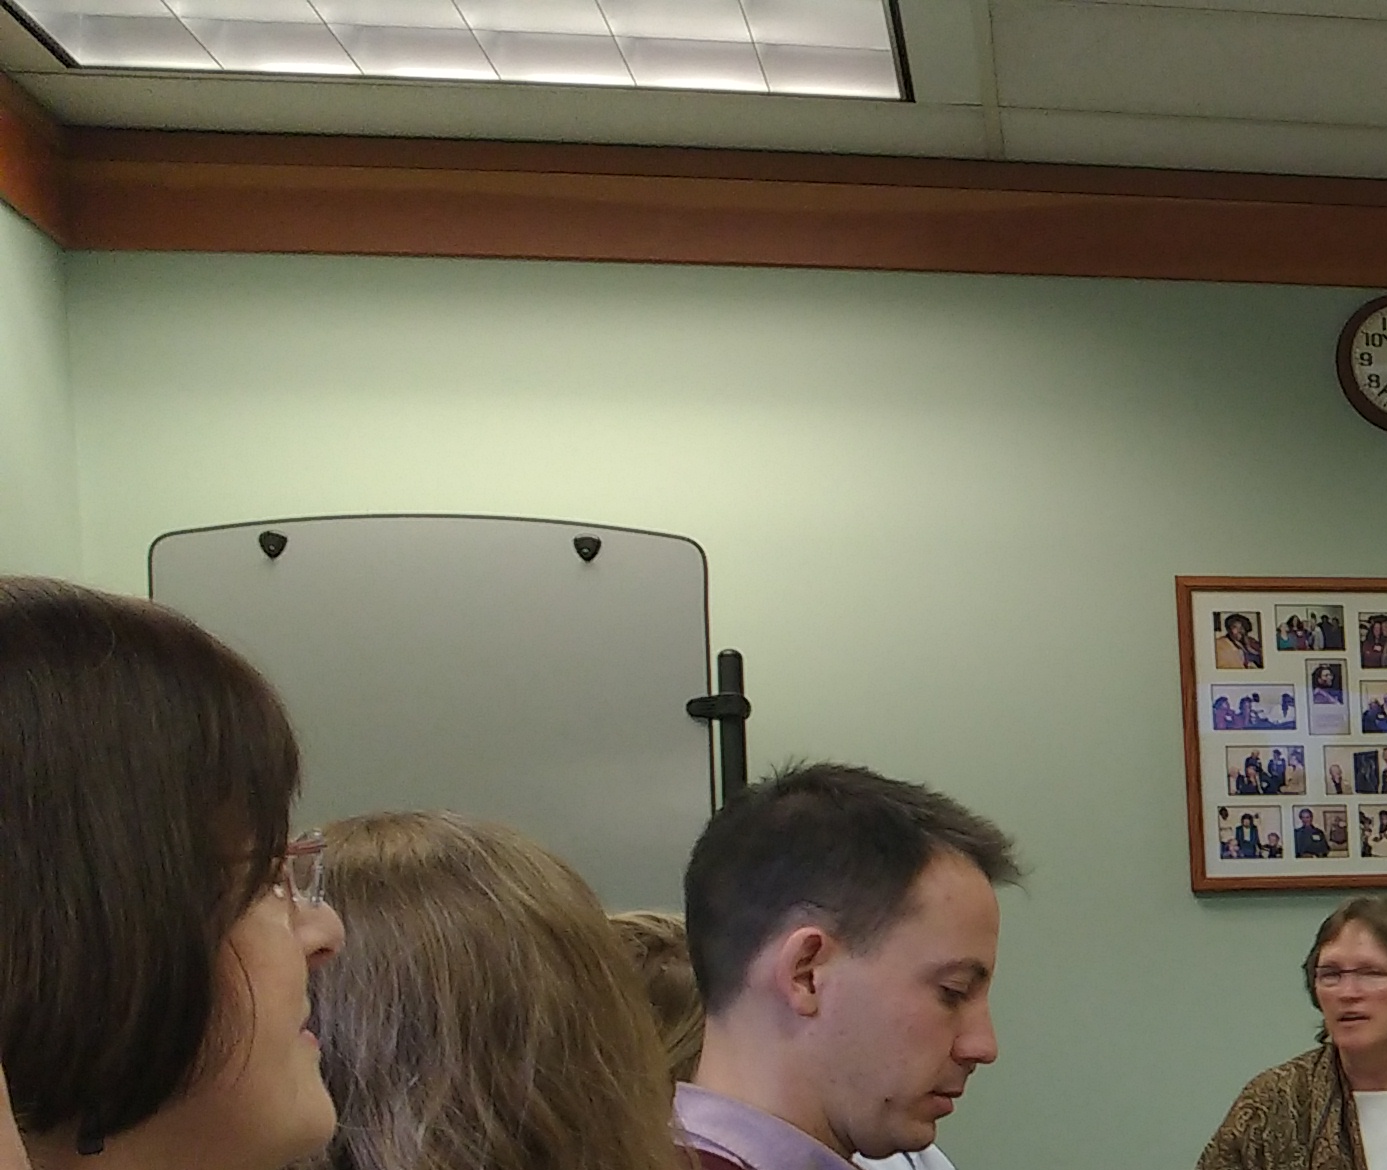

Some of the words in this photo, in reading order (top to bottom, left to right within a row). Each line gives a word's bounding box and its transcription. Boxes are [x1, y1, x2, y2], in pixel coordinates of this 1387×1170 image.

[1365, 332, 1383, 347] 10
[1359, 352, 1373, 366] 9
[1367, 373, 1381, 388] 8
